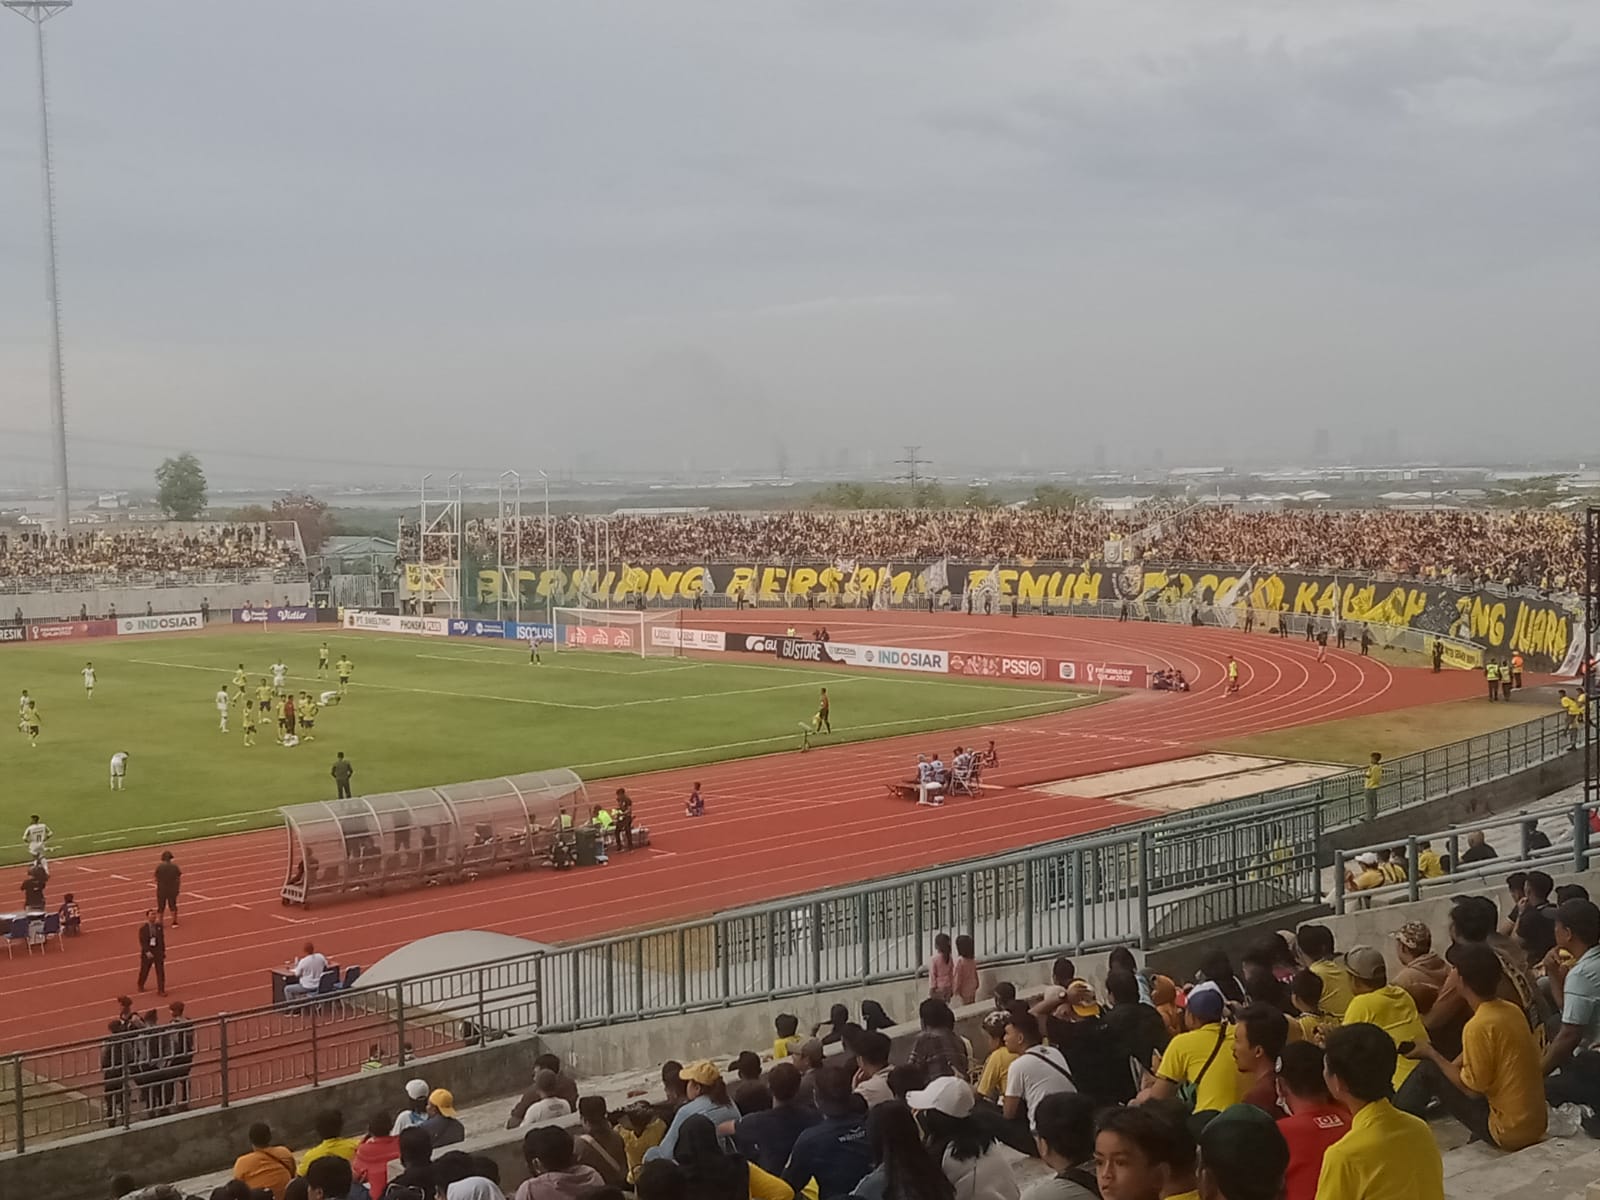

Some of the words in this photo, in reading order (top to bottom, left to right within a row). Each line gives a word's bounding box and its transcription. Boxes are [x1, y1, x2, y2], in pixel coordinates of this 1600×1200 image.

[138, 616, 198, 630] INDOSIAR
[878, 650, 942, 668] INDOSIAR
[1002, 658, 1029, 676] PSSI
